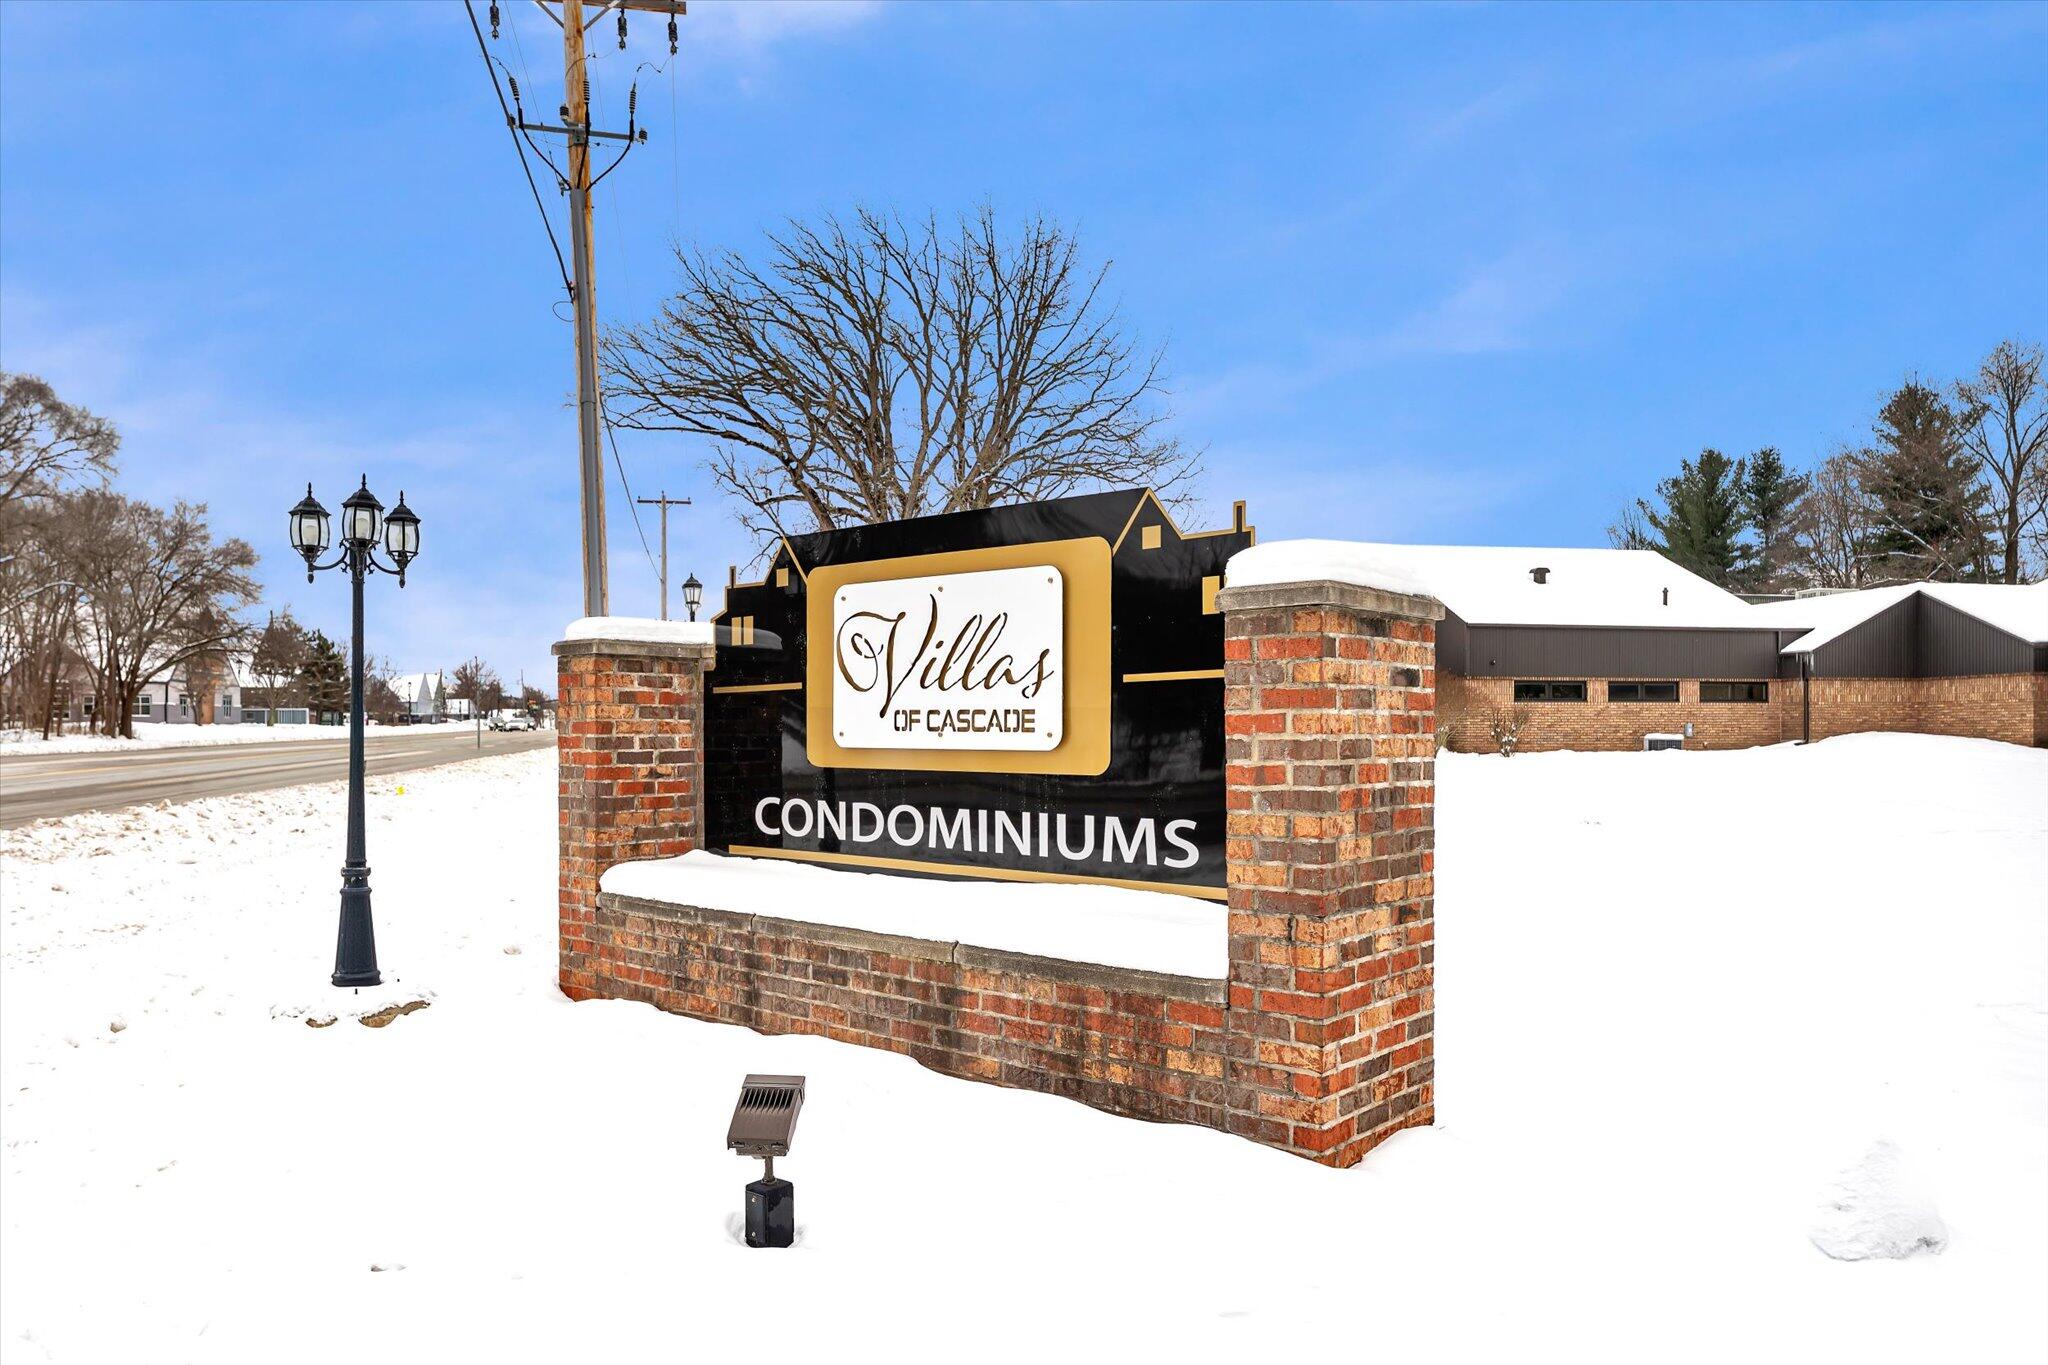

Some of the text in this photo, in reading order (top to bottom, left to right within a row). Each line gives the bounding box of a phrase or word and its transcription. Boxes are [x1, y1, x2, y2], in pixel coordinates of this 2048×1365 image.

[836, 593, 1055, 719] Villas
[893, 708, 1036, 734] OF CASCADE
[754, 796, 1201, 870] CONDOMINIUMS
